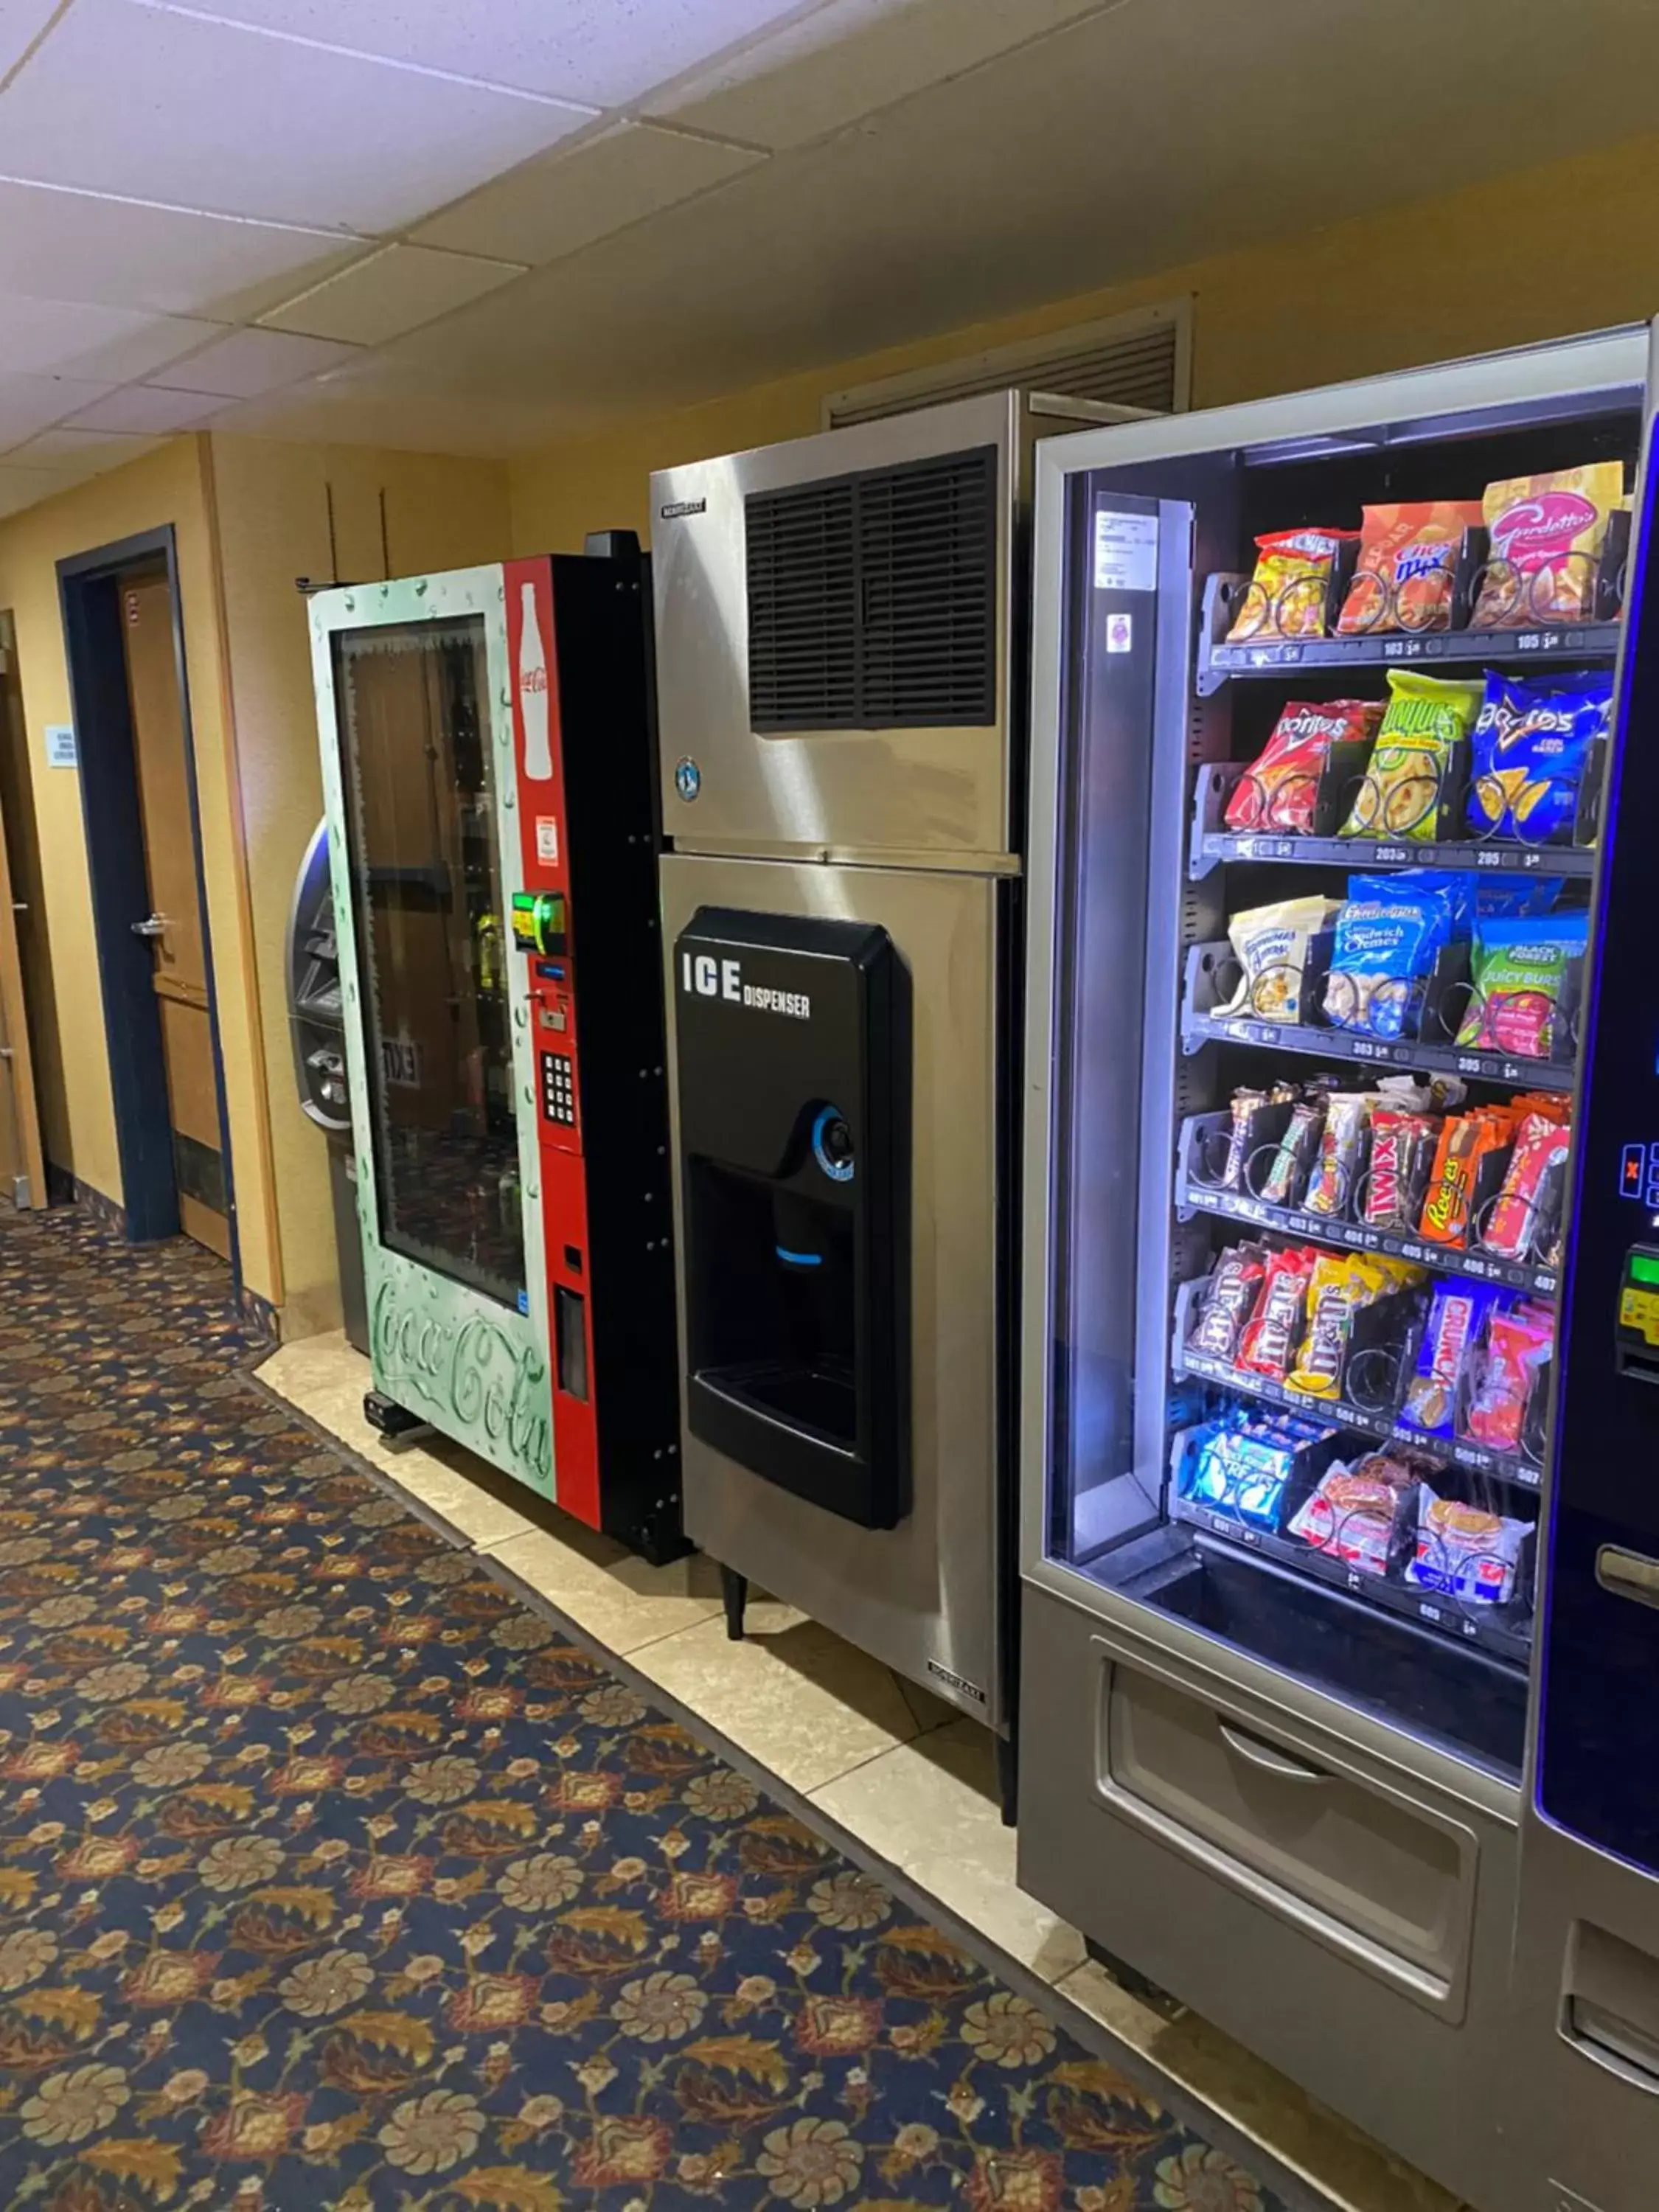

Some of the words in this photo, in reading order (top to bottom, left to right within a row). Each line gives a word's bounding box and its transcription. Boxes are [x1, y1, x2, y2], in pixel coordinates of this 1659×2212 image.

[683, 953, 741, 1001] ICE
[743, 984, 810, 1018] DISPENSER
[1523, 971, 1562, 987] BURS
[1366, 1135, 1398, 1223] TWIX
